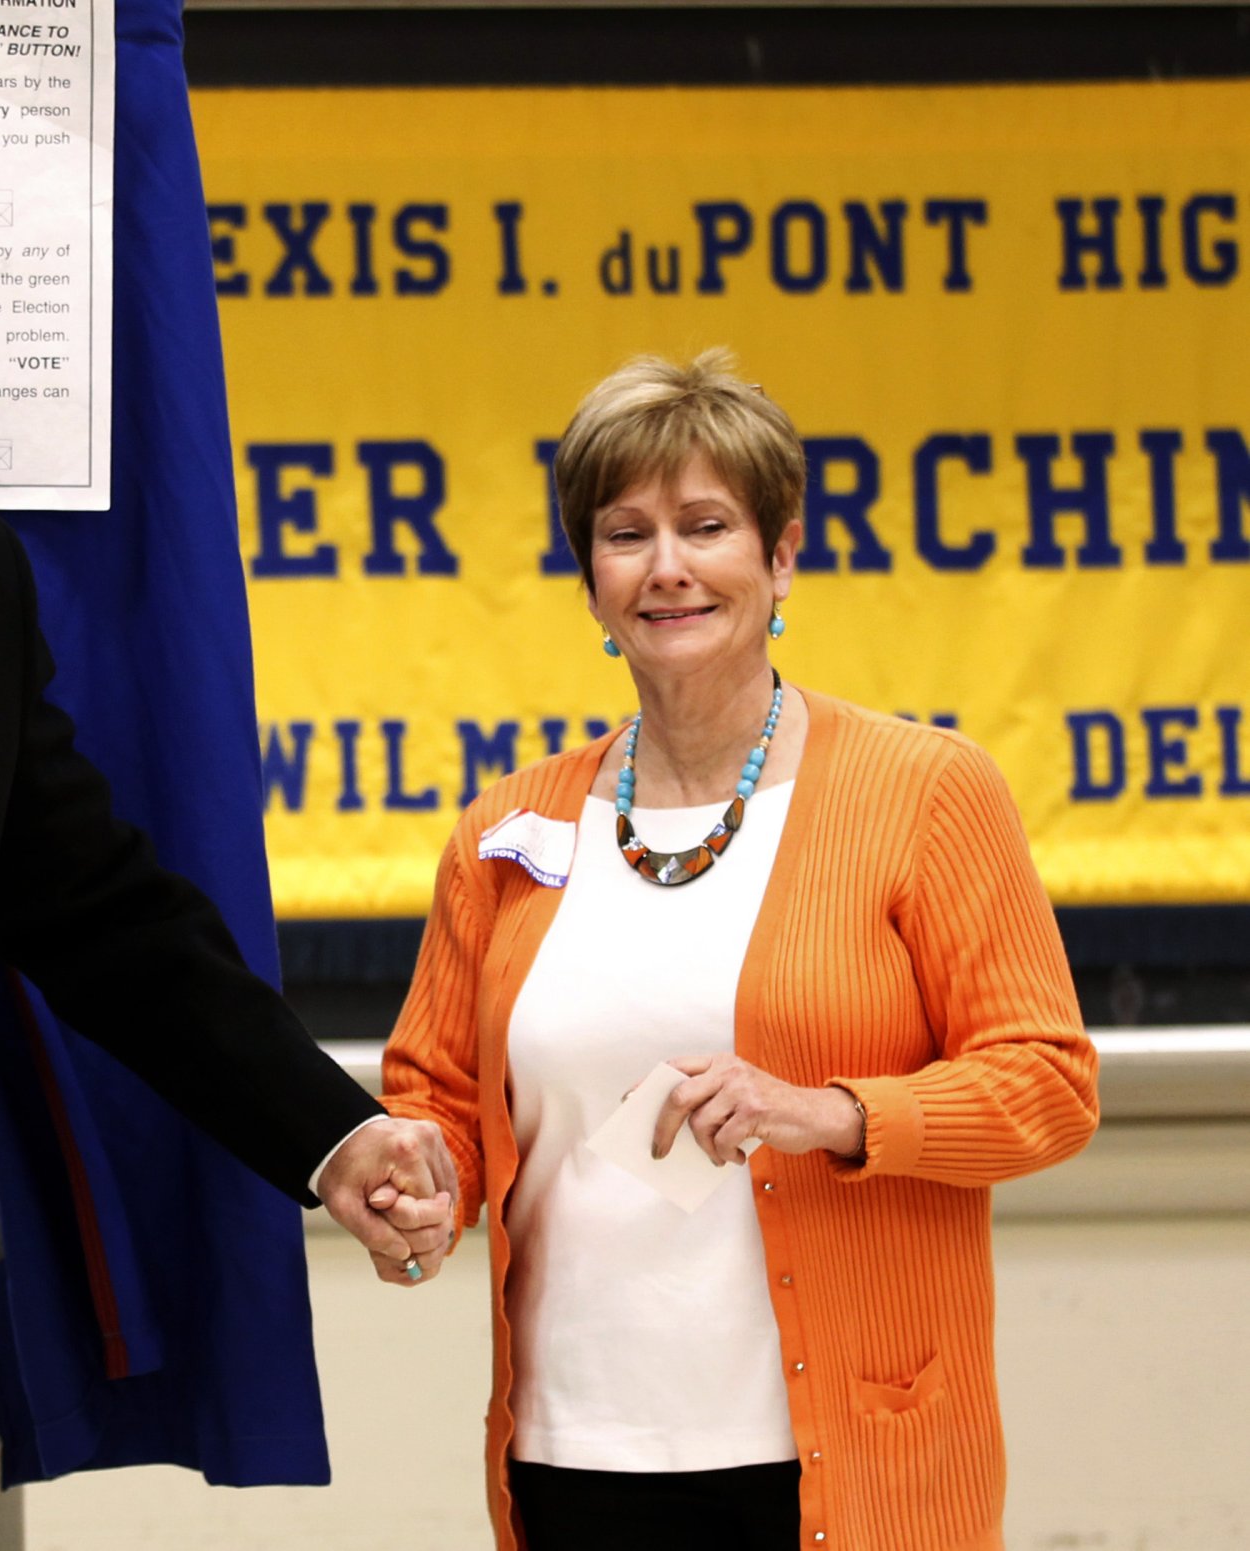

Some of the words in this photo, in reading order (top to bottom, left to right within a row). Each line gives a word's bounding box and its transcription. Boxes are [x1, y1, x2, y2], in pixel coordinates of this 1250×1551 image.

[49, 26, 69, 39] TO
[7, 43, 81, 57] BUTTON!
[24, 75, 42, 91] by
[48, 76, 71, 89] the
[20, 106, 71, 119] person
[2, 134, 29, 147] you
[35, 131, 71, 147] push
[22, 247, 49, 260] any
[56, 244, 70, 257] of
[493, 200, 559, 297] I.
[598, 197, 989, 297] duPONT
[1, 273, 23, 285] the
[28, 274, 70, 288] green
[12, 300, 70, 314] Election
[6, 329, 70, 344] problem.
[43, 387, 70, 398] can
